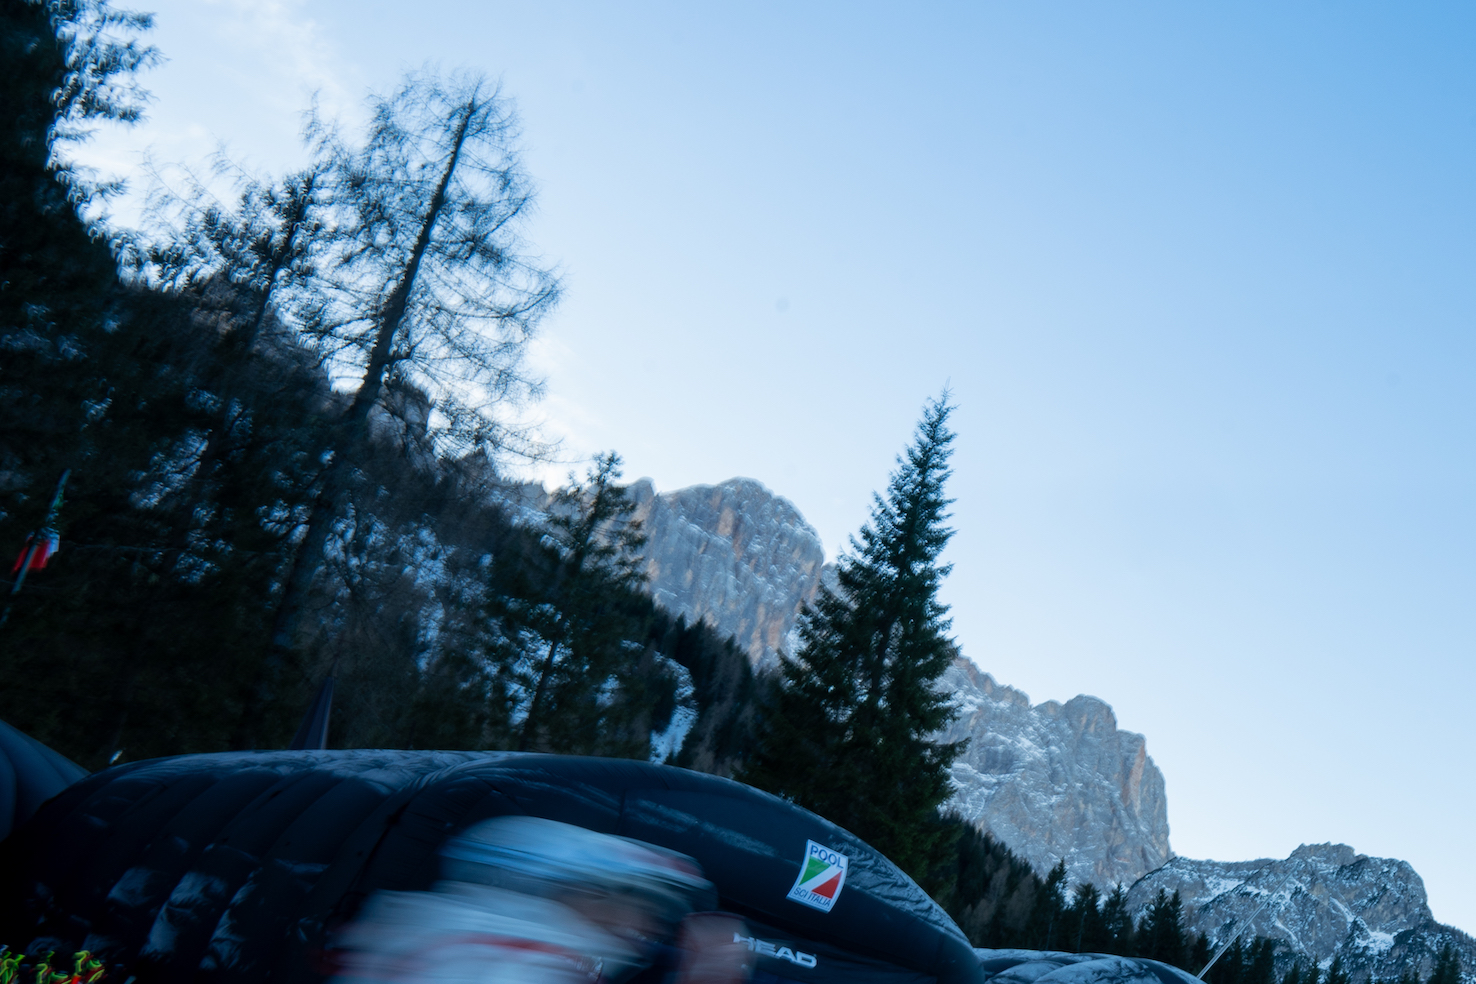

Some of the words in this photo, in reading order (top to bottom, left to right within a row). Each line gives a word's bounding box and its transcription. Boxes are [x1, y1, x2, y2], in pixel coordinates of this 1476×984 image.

[810, 844, 844, 869] POOL
[793, 887, 809, 898] SCI
[808, 893, 831, 907] ITALIA
[733, 932, 818, 970] HEAD
